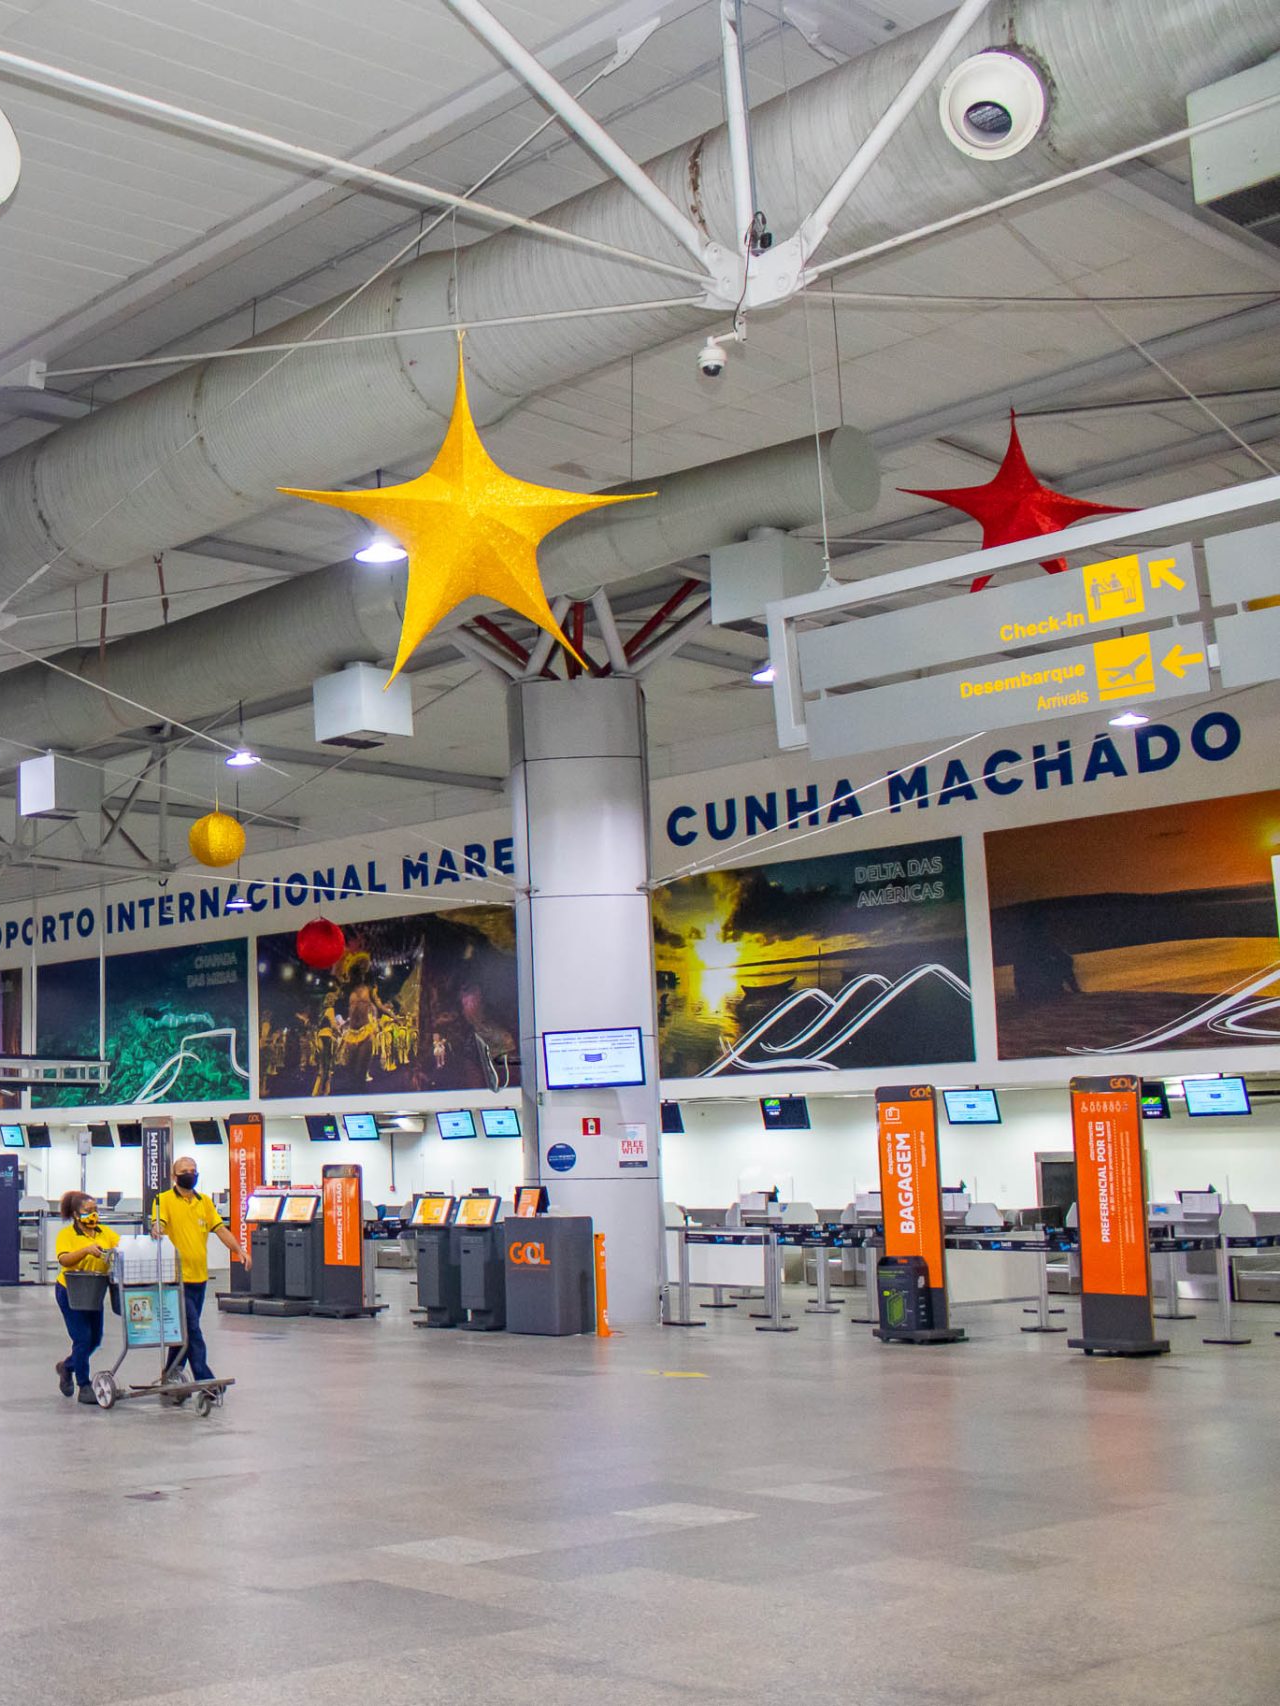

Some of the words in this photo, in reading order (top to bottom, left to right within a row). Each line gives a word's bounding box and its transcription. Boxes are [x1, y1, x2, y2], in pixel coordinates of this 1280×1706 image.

[999, 611, 1086, 642] Check-In
[959, 662, 1086, 699] Desembarque
[1036, 688, 1090, 712] Arrivals
[106, 861, 387, 935] INTERNACIONAL
[666, 778, 863, 847] CUNHA
[887, 711, 1242, 814] MACHADO
[854, 861, 906, 884] DELTA
[907, 856, 943, 877] DAS
[857, 881, 945, 908] AMÉRICAS
[909, 1087, 931, 1098] GOL
[1110, 1077, 1137, 1090] GOL
[1095, 1121, 1105, 1137] LEI
[621, 1140, 644, 1148] FREE
[1096, 1140, 1107, 1162] POR
[150, 1132, 159, 1190] PREMIUM
[895, 1132, 916, 1234] BAGAGEM
[1097, 1165, 1111, 1243] PREFERENCIAL
[509, 1241, 551, 1265] GOL
